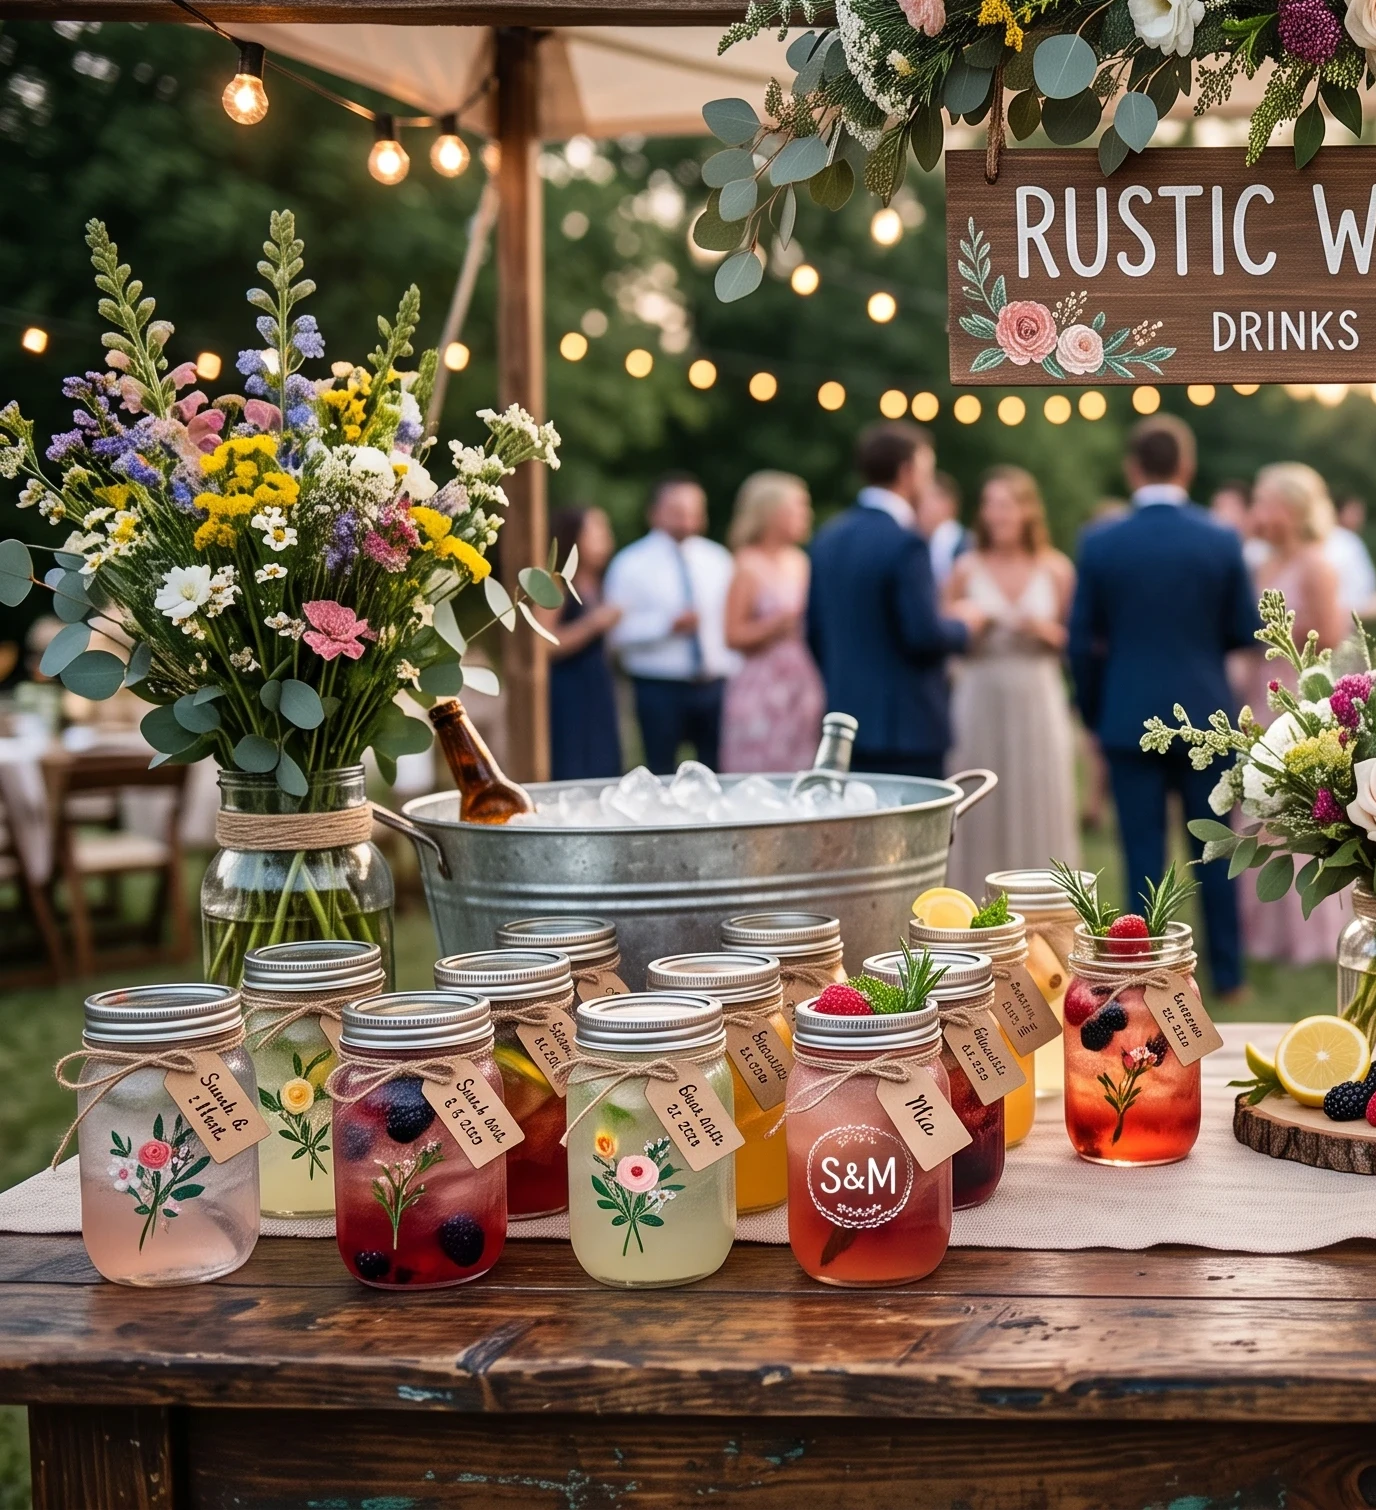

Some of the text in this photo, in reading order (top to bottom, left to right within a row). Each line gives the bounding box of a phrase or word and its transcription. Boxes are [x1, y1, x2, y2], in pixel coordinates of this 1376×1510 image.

[1015, 184, 1277, 279] RUSTIC
[1212, 309, 1360, 353] DRINKS
[904, 1094, 935, 1136] Mia
[820, 1156, 896, 1195] S&M
